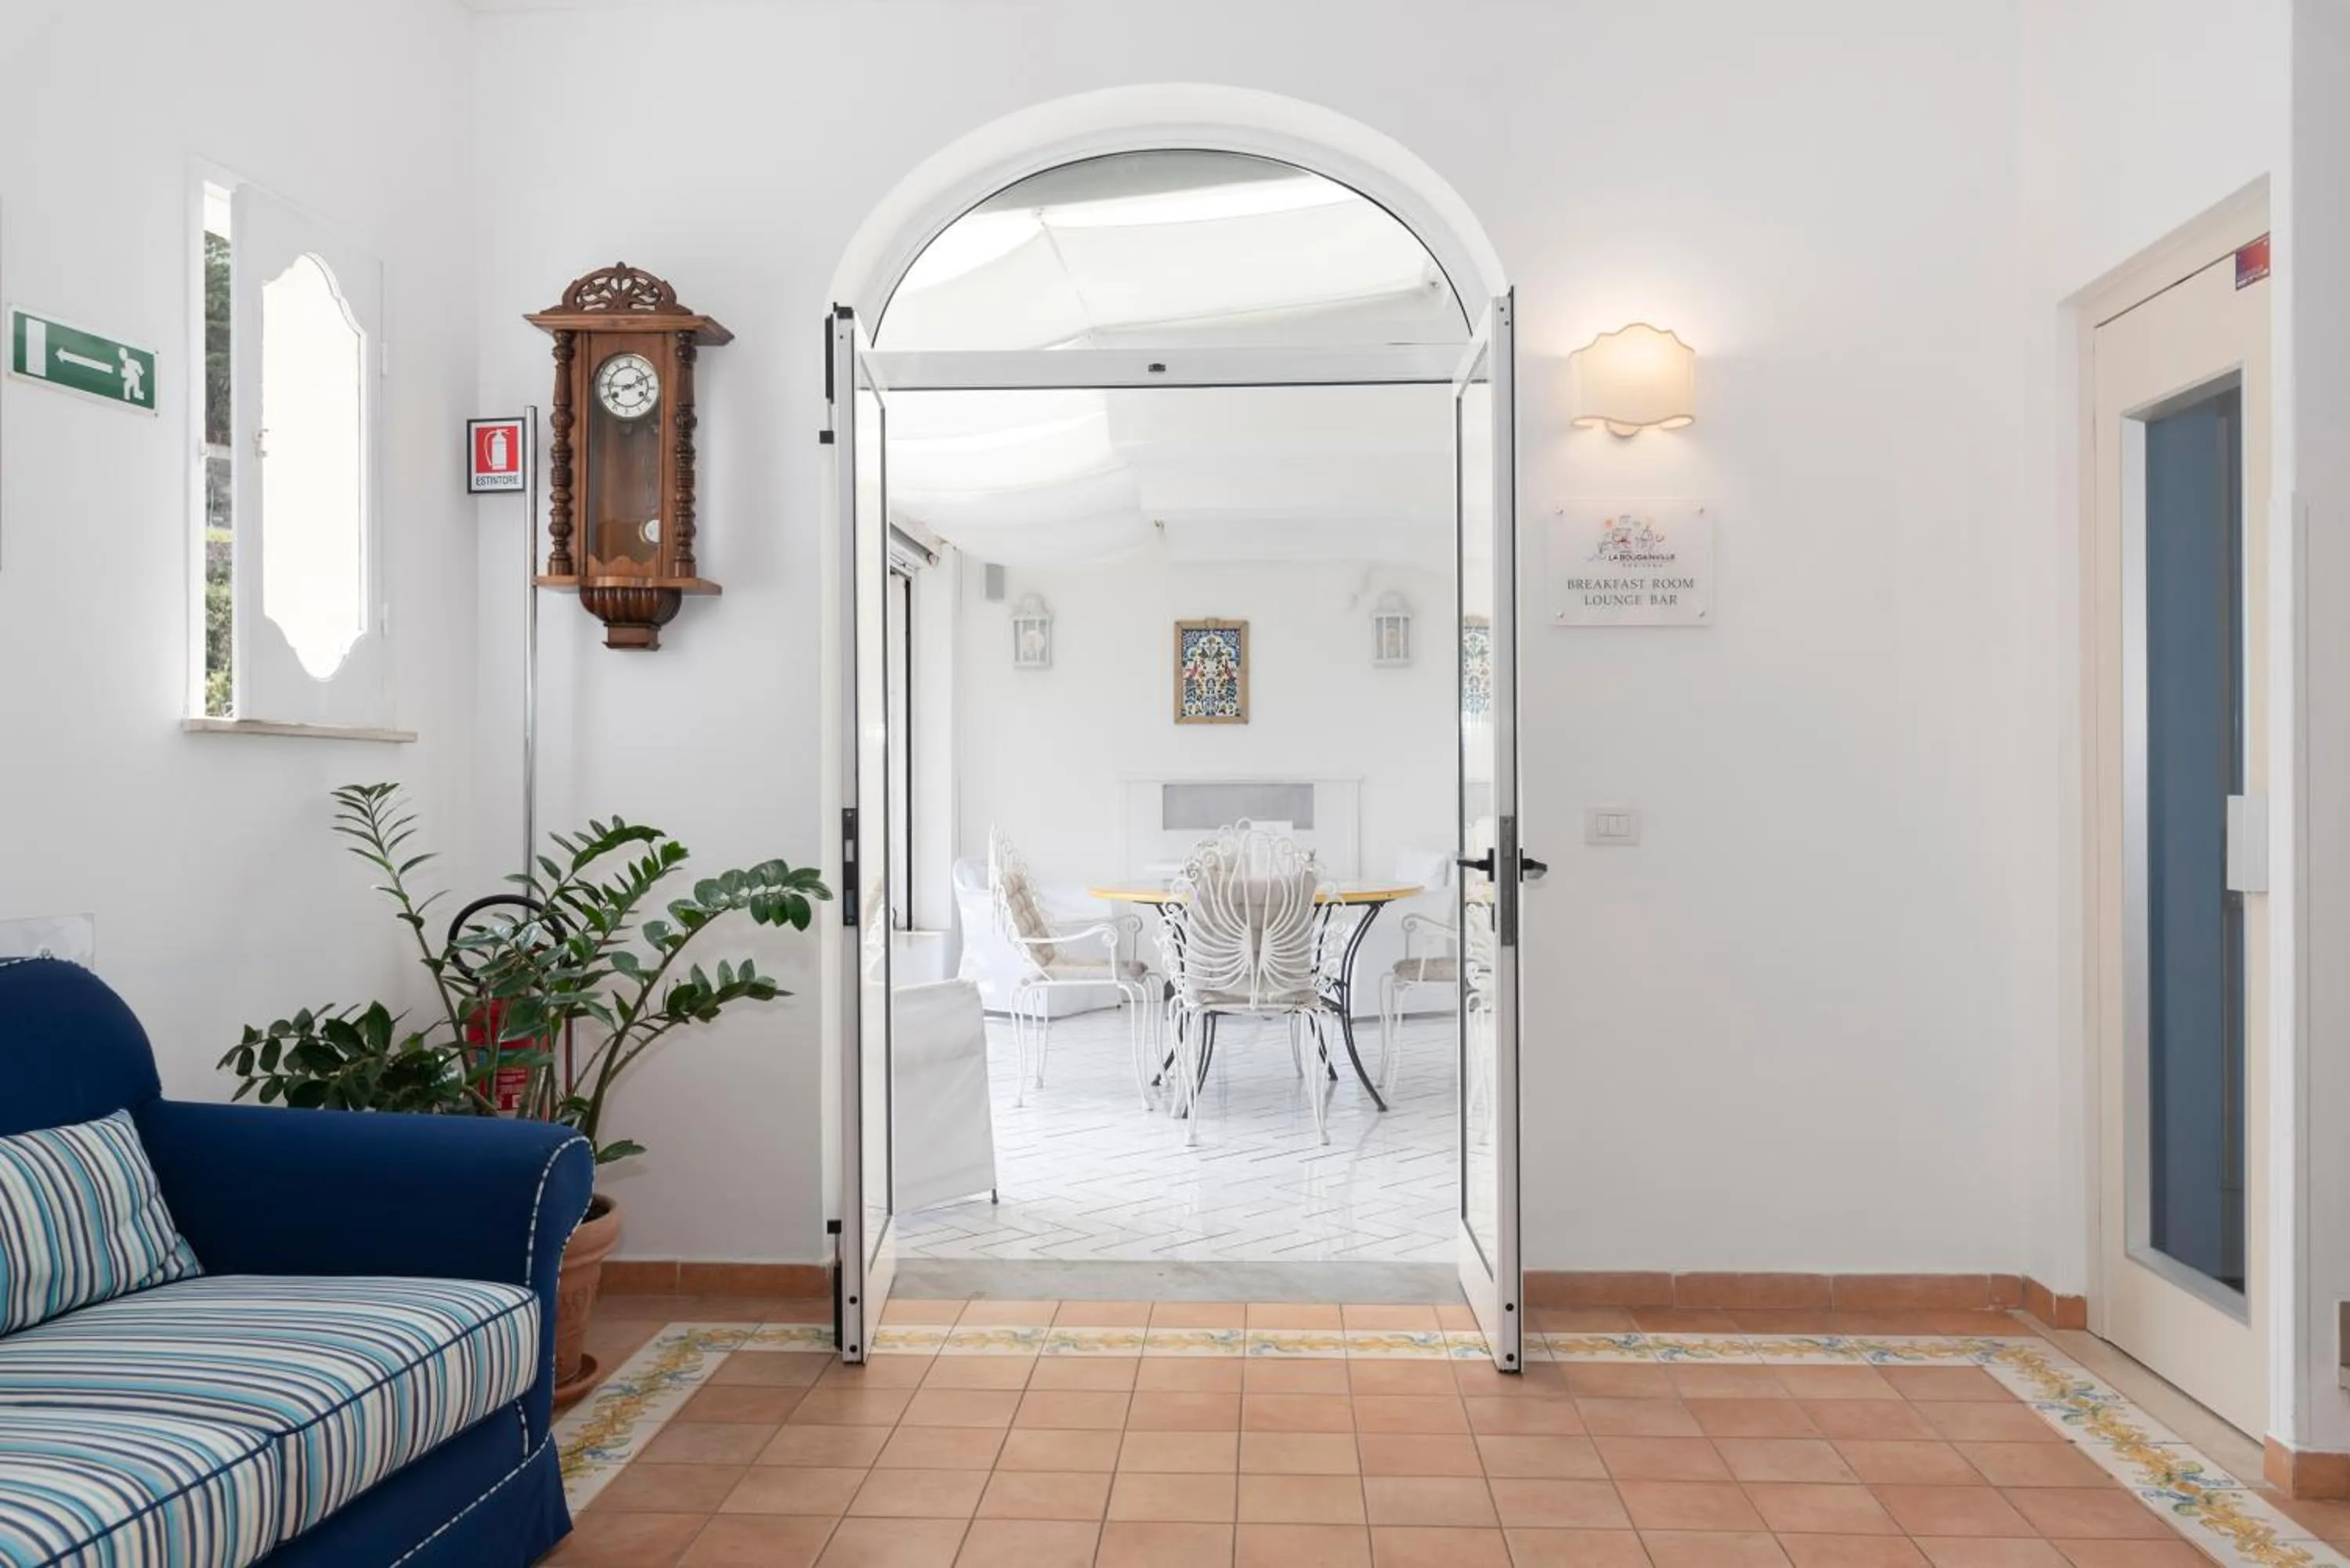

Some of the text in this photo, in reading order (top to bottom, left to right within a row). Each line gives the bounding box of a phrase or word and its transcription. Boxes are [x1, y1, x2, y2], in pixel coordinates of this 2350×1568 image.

[475, 475, 520, 486] ESTINTORE
[1608, 553, 1618, 562] LA
[1567, 577, 1694, 590] BREAKFAST ROOM
[1585, 594, 1678, 605] LOUNGE BAR
